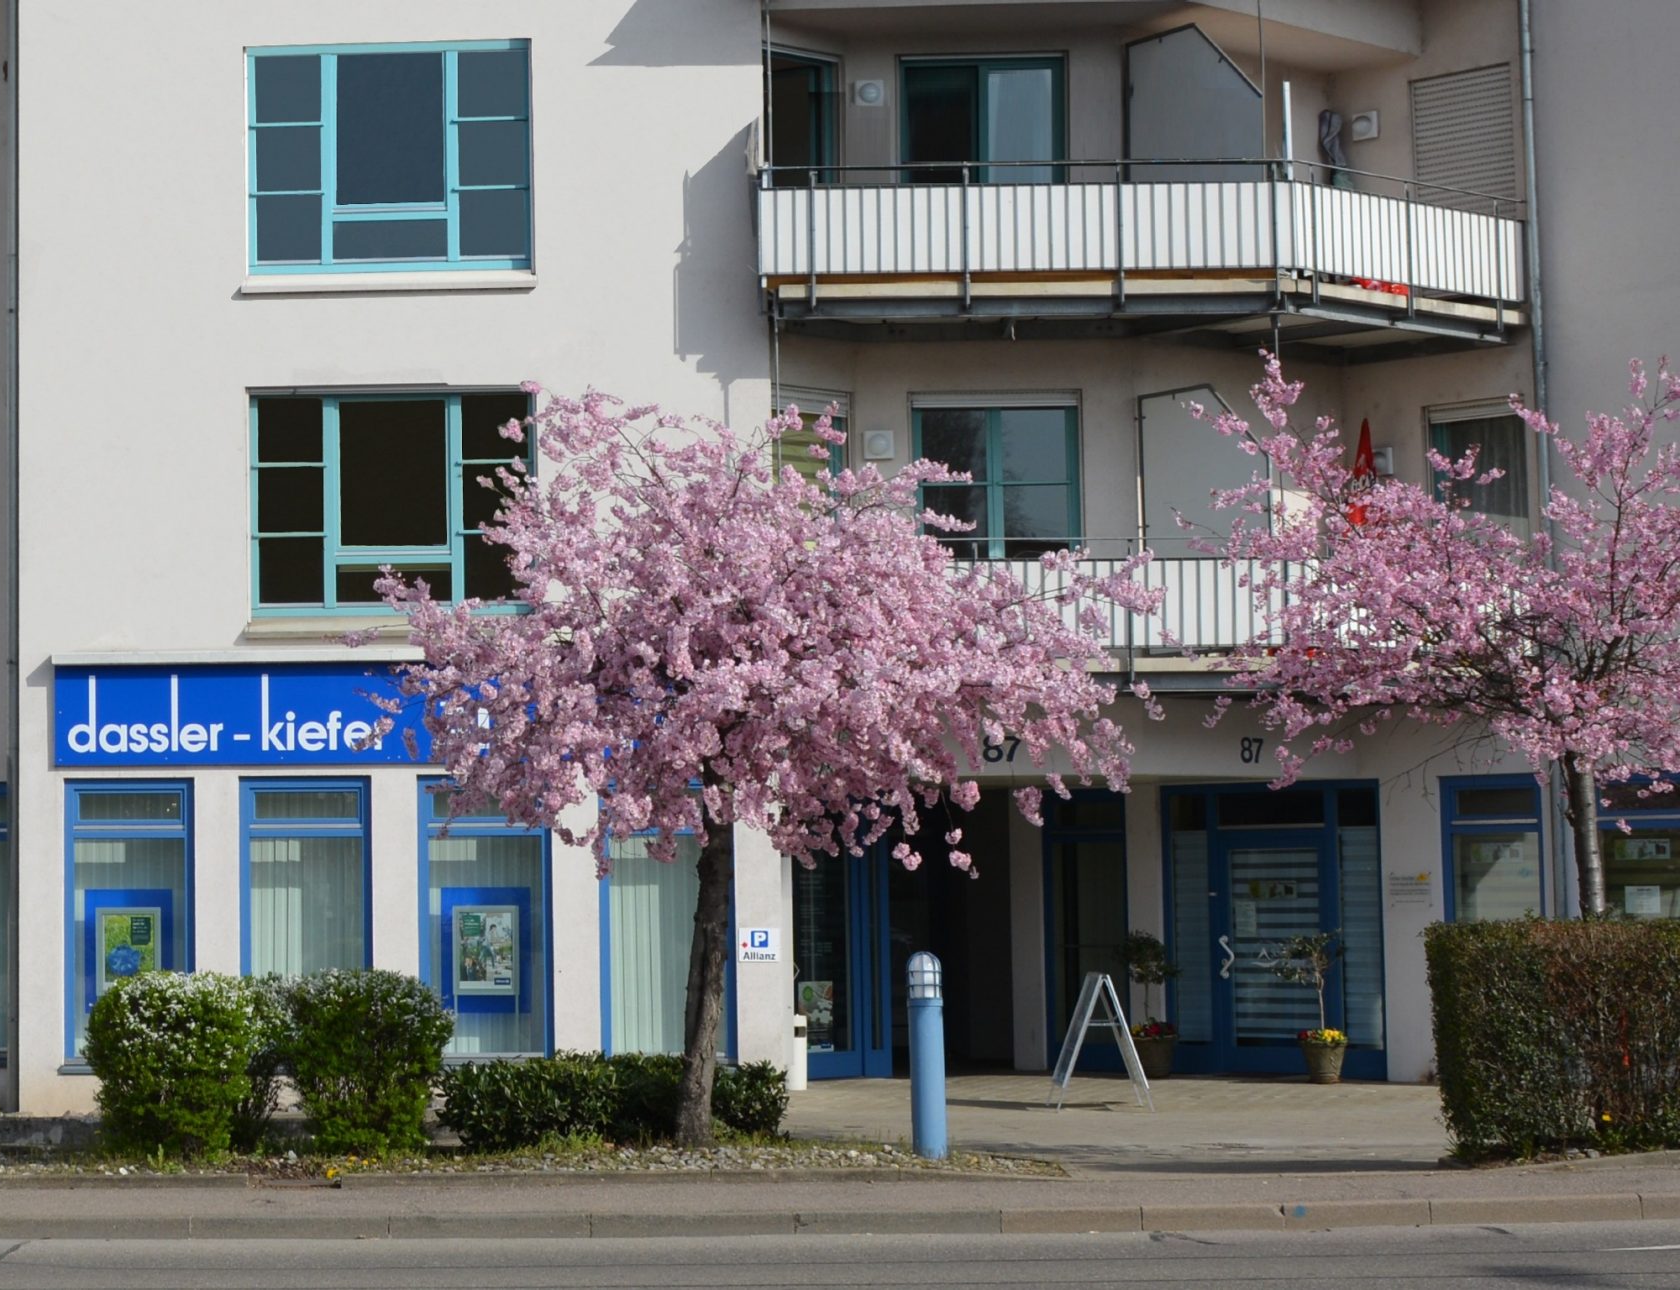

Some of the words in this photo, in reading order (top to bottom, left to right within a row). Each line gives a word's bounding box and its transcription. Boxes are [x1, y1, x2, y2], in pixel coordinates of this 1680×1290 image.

[67, 675, 224, 753] dassler
[982, 734, 1022, 763] 87
[1240, 736, 1264, 764] 87
[753, 932, 767, 947] P
[743, 951, 776, 961] Allianz
